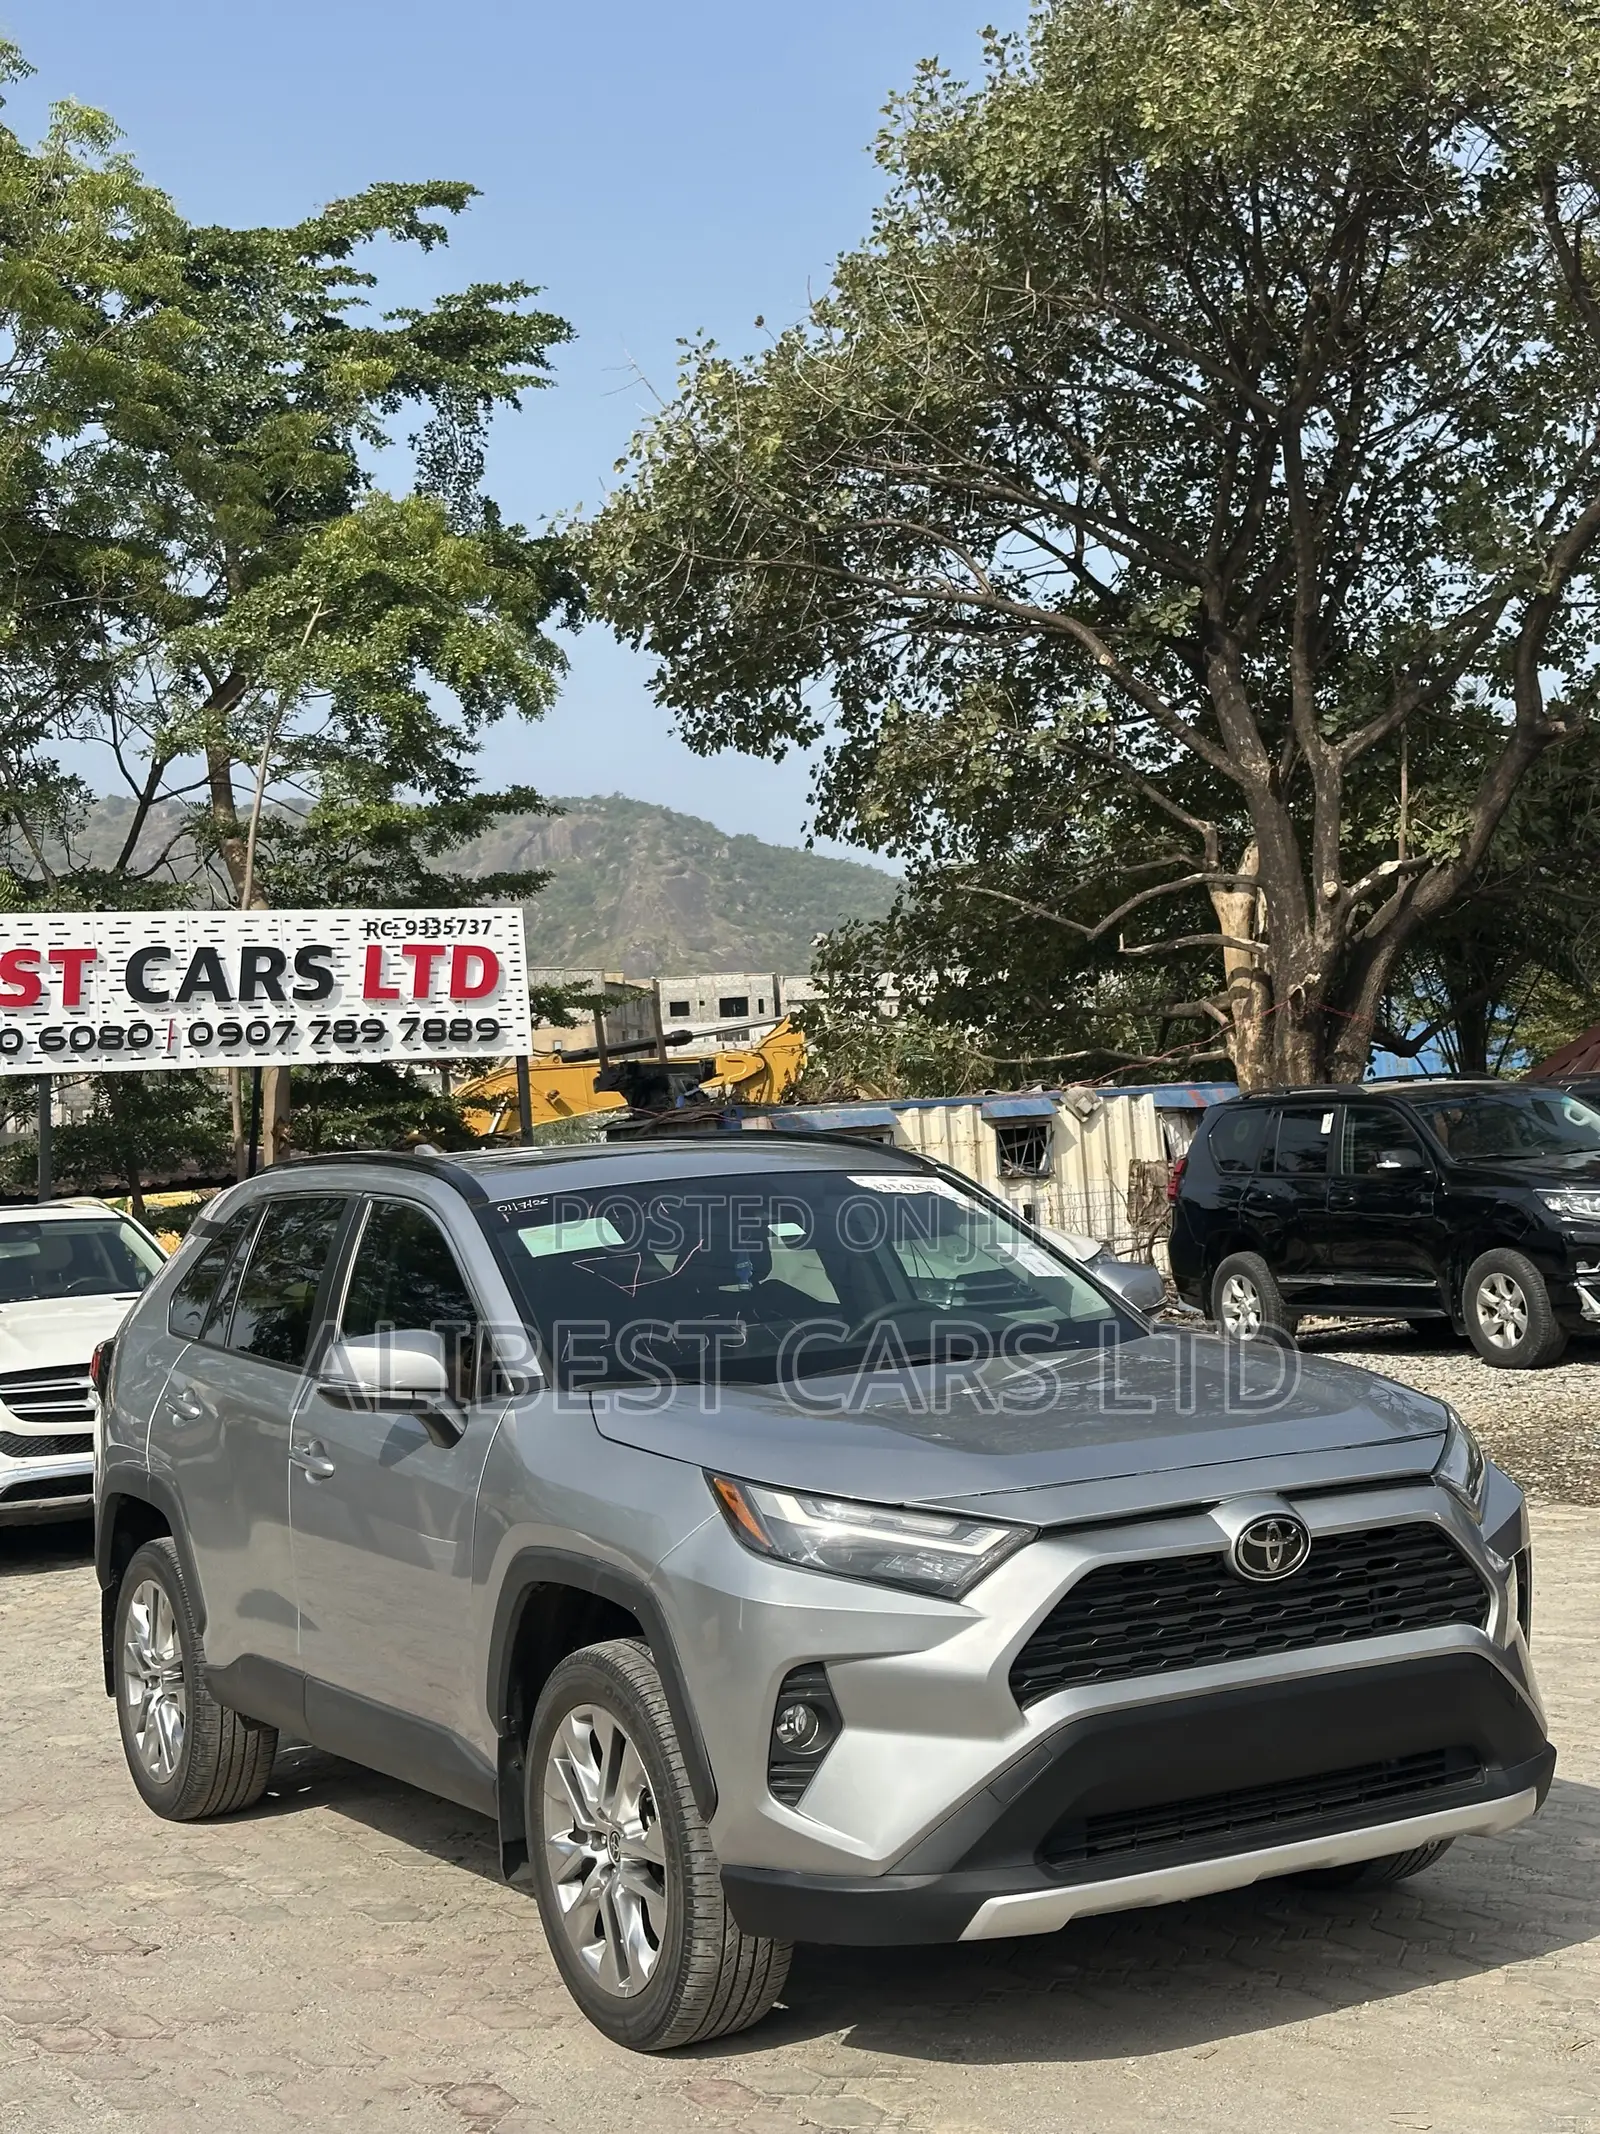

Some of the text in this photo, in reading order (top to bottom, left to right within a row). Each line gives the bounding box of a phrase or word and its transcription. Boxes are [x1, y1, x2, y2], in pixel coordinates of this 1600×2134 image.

[405, 919, 492, 936] 9335737
[0, 944, 499, 1009] ST CARS LTD
[38, 1023, 154, 1052] 6080
[188, 1020, 296, 1046] 0907
[309, 1019, 386, 1044] 789
[400, 1017, 501, 1042] 7889
